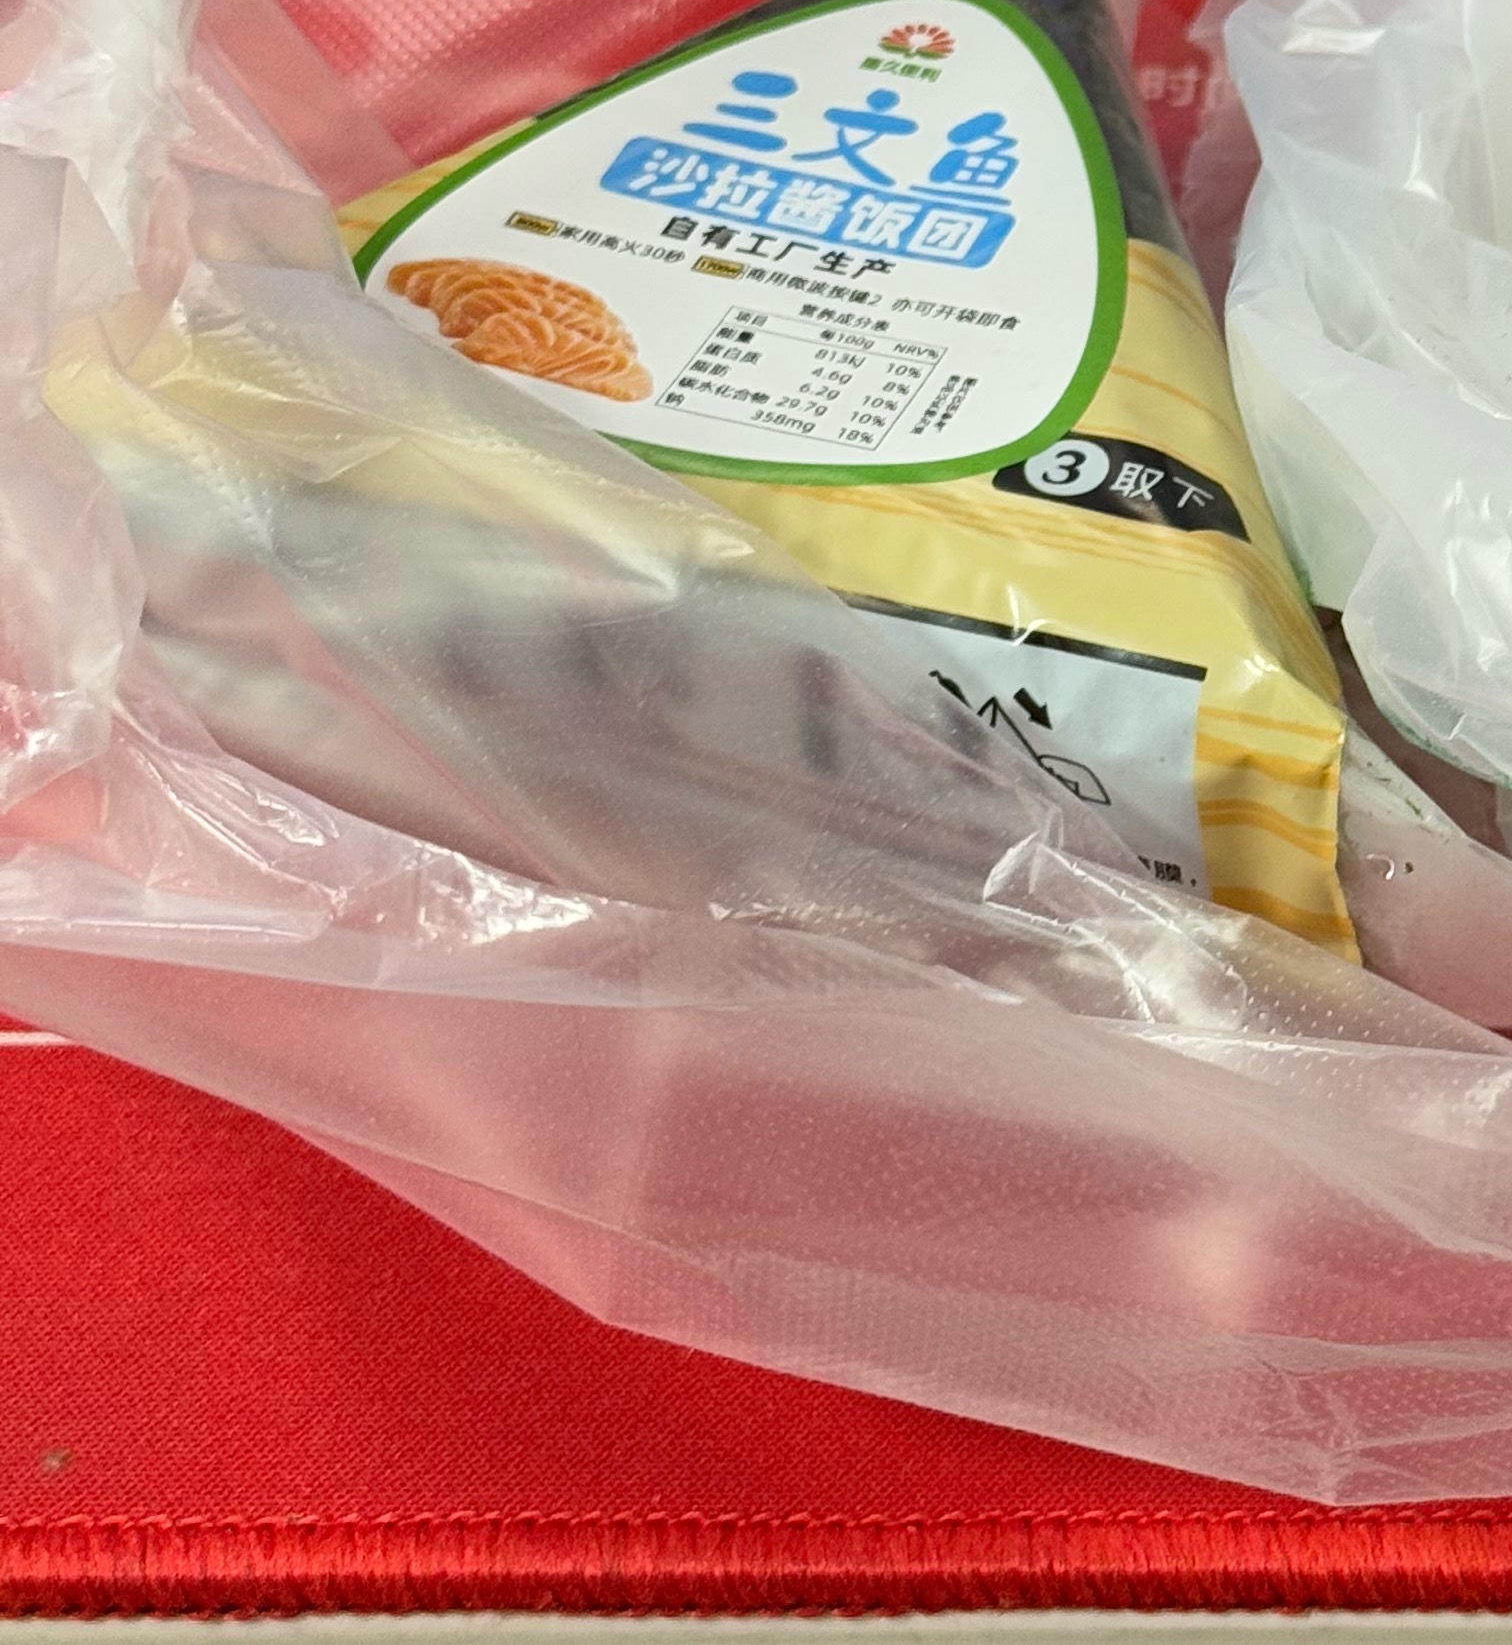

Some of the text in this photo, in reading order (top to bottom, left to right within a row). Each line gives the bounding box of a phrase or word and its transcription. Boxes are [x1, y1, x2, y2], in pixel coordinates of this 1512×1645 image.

[682, 71, 1020, 207] 三文鱼
[629, 149, 989, 260] 沙拉酱饭团
[661, 216, 897, 279] 自有工厂生产
[799, 303, 890, 332] 营养成分表
[891, 297, 1022, 331] 亦可开袋即食
[885, 362, 922, 379] 10%
[850, 410, 887, 428] 10%
[861, 395, 899, 412] 10%
[1109, 461, 1215, 509] 取下
